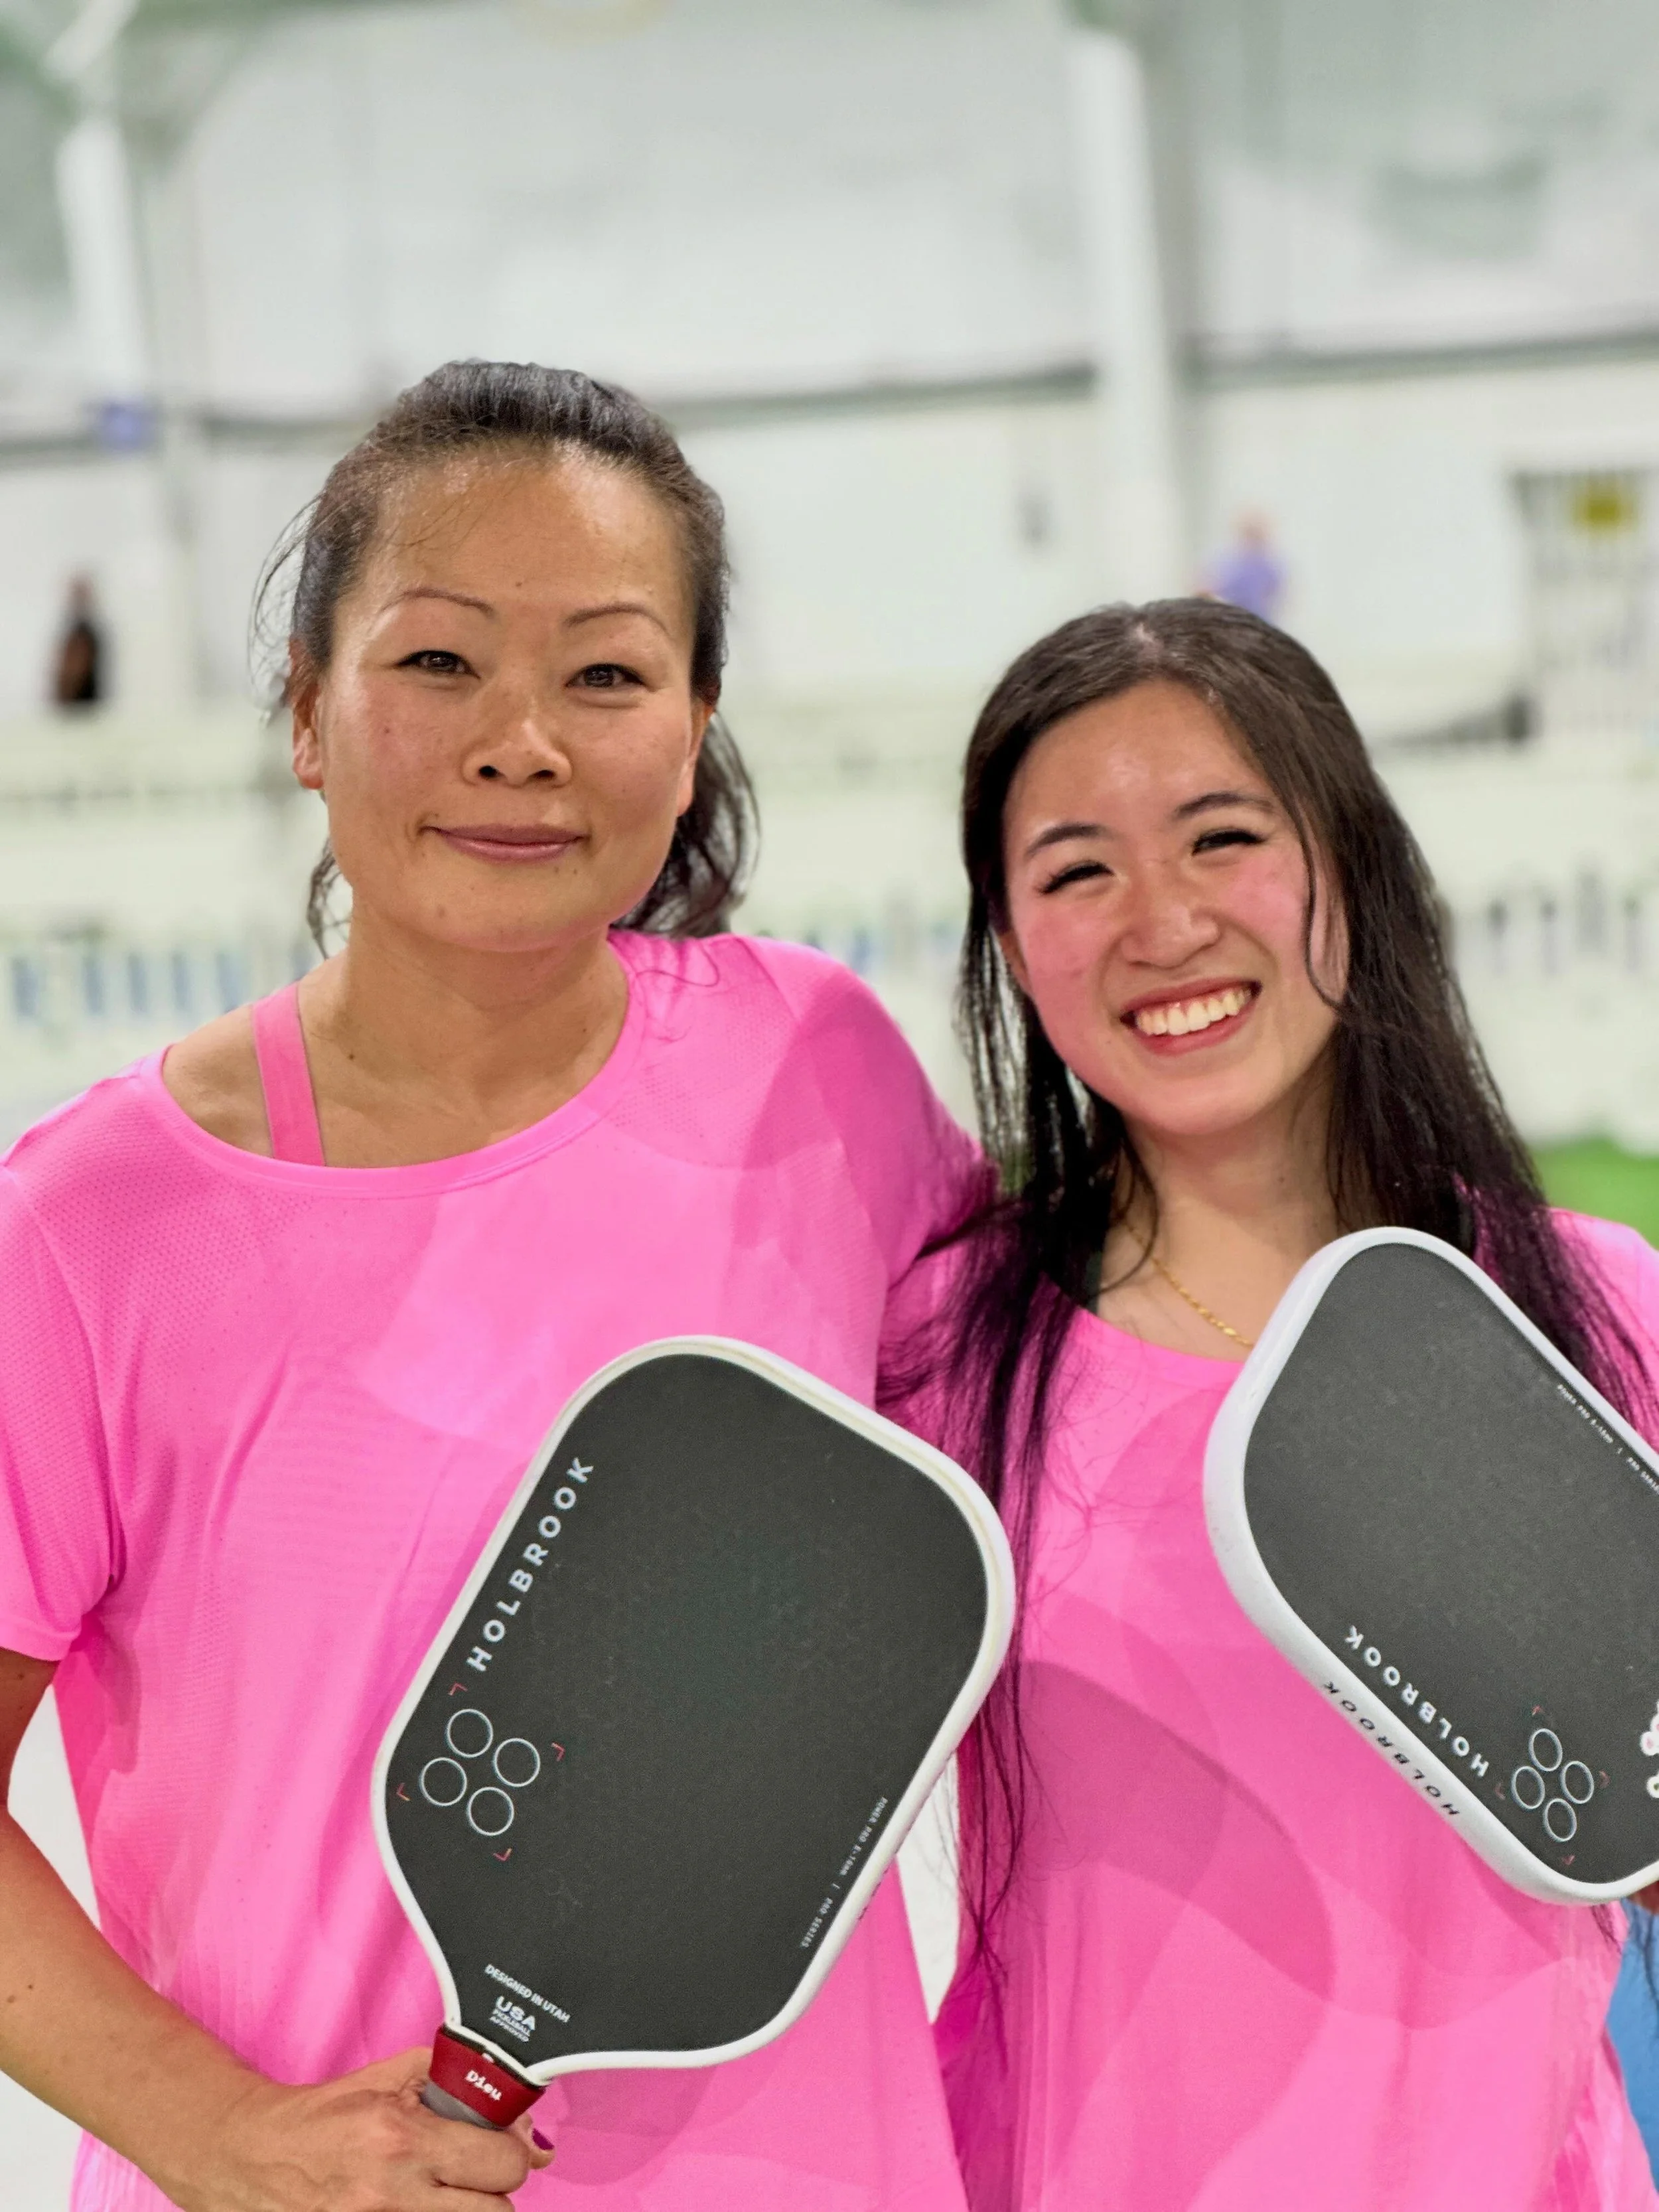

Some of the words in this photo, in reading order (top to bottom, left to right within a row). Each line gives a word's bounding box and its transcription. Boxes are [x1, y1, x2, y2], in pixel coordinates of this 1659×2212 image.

[466, 1457, 594, 1671] HOLBROOK
[1345, 1625, 1488, 1777] HOLBROOK
[1324, 1682, 1460, 1815] HOLBROOK
[859, 1825, 873, 1842] PRO
[868, 1797, 889, 1824] POWER
[800, 1917, 823, 1949] SERIES
[484, 1964, 532, 1998] DESIGNED
[531, 1993, 544, 2006] IN
[542, 2000, 571, 2023] UTAH
[496, 1996, 536, 2031] USA
